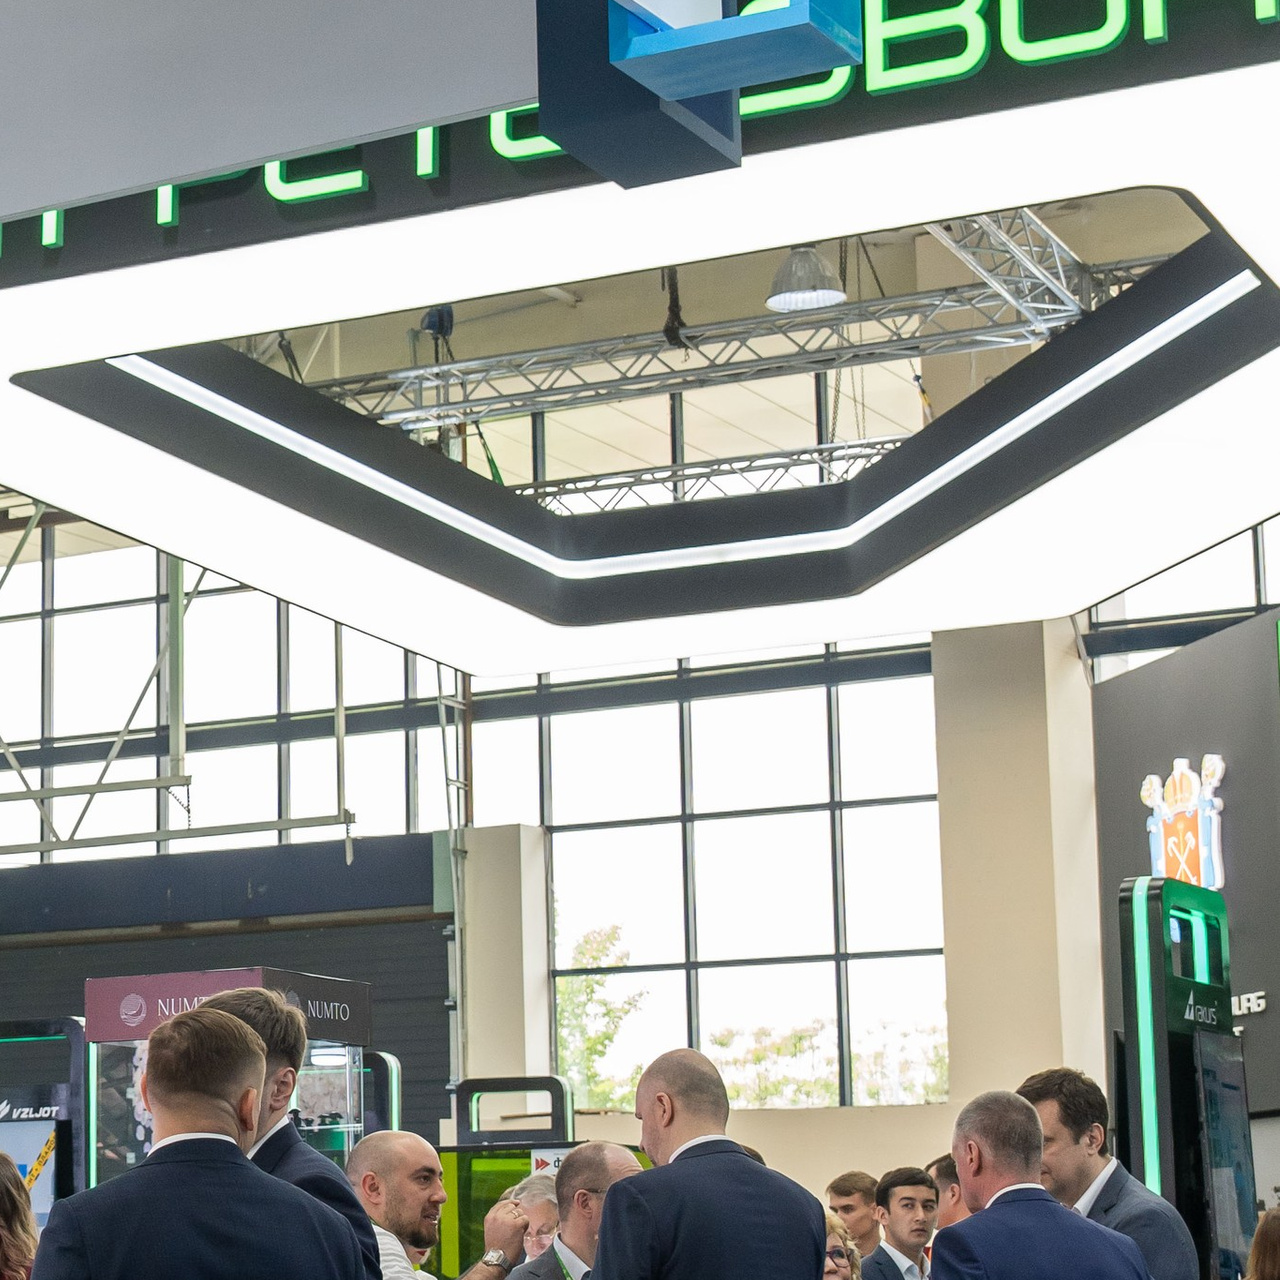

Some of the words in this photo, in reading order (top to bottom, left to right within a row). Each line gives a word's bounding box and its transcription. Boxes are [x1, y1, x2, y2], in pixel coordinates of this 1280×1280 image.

[157, 995, 209, 1017] NUM
[307, 999, 350, 1021] NUMTO
[12, 1106, 59, 1119] VZLJOT
